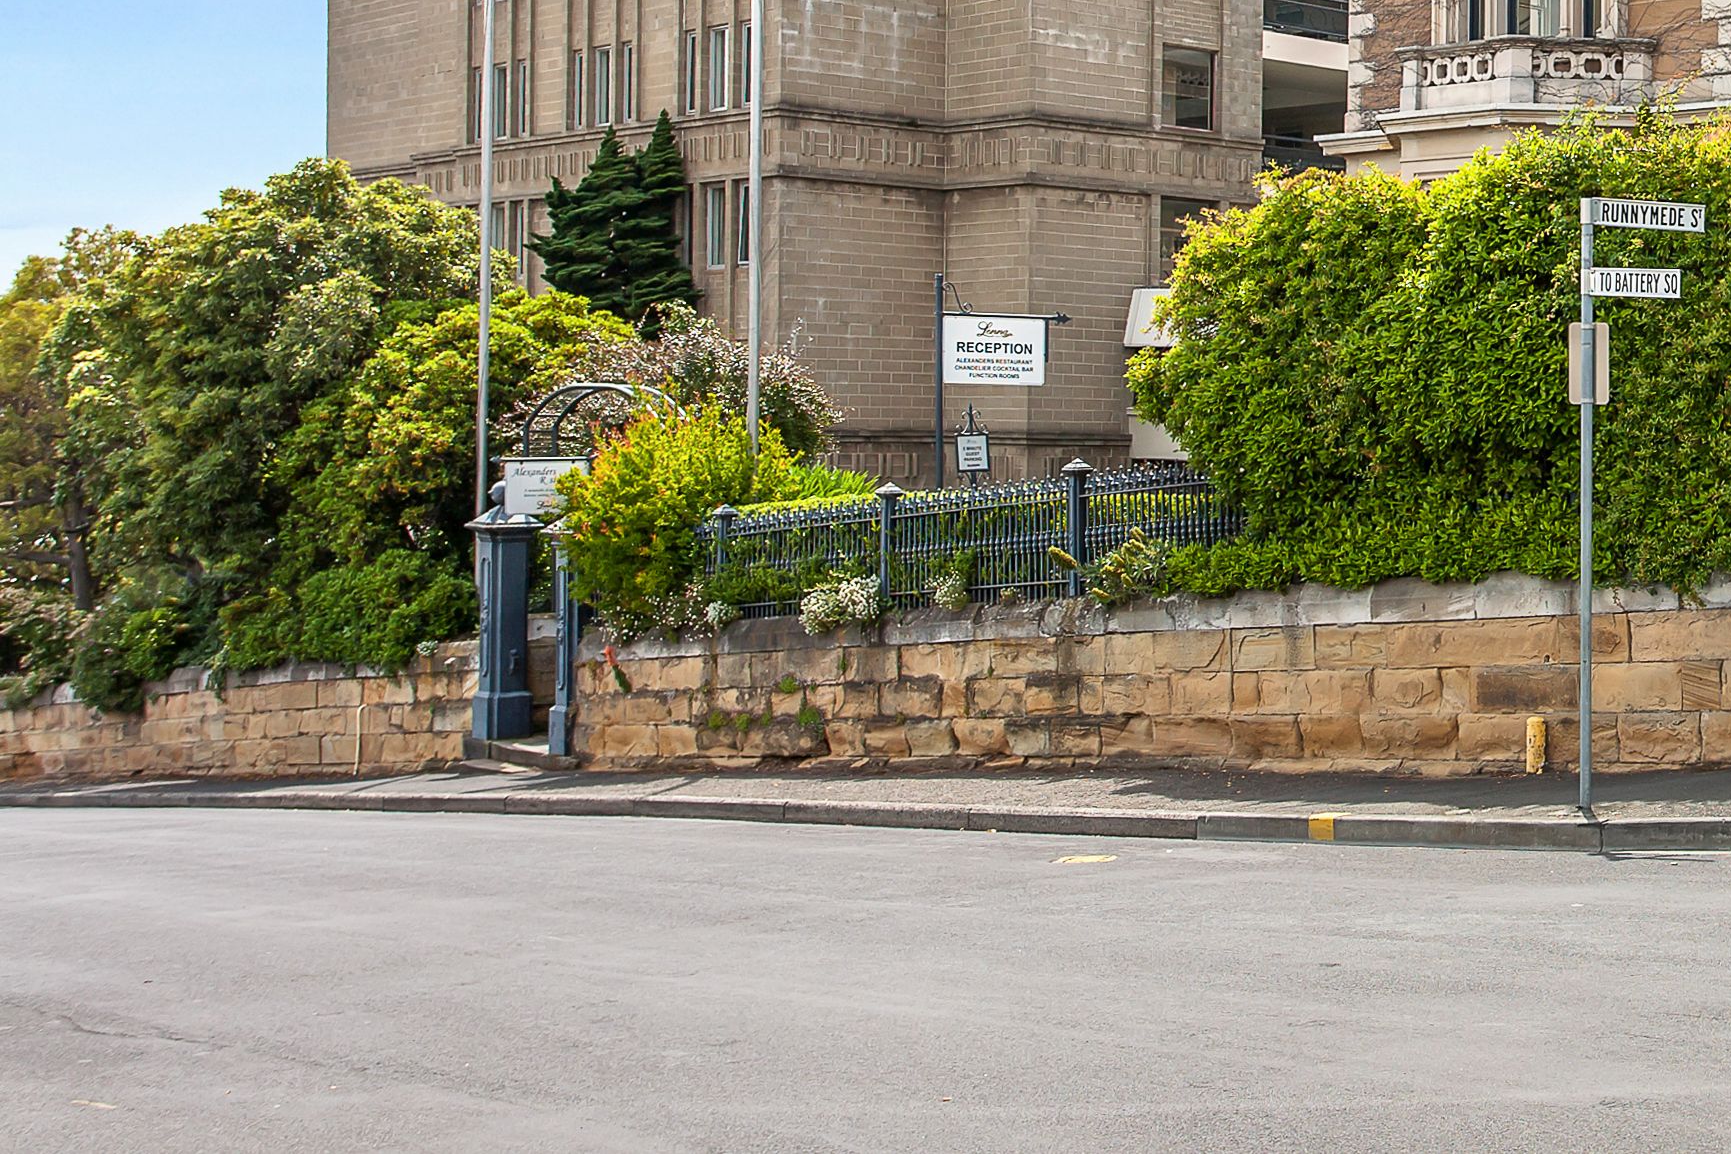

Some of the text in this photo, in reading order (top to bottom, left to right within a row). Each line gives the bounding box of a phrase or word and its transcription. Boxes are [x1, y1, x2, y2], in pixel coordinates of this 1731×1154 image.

[1601, 202, 1686, 227] RUNNYMEDE
[1599, 272, 1678, 295] TO BATTERY SQ
[956, 341, 1033, 355] RECEPTION
[511, 467, 557, 477] Alexanders
